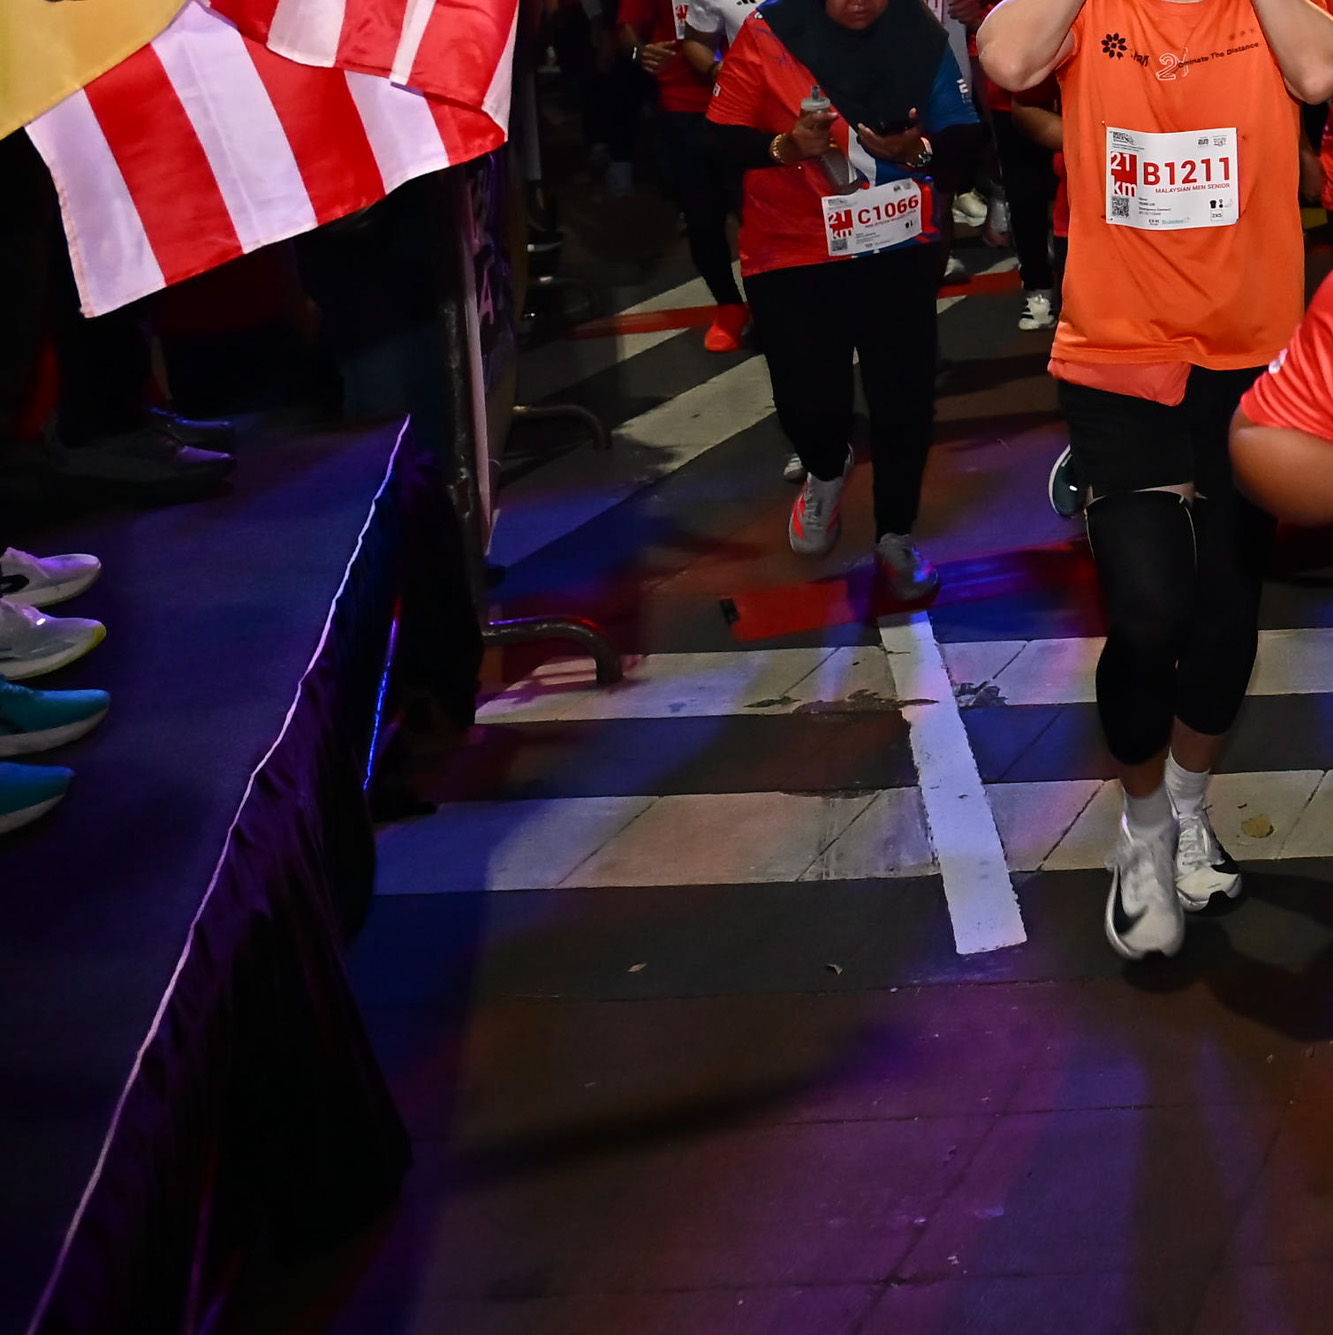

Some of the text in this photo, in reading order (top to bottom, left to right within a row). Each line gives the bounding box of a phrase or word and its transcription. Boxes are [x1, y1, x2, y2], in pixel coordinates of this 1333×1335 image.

[1226, 42, 1260, 55] Distance
[1111, 152, 1230, 186] 21 B1211
[1114, 181, 1137, 197] km
[1155, 186, 1191, 194] MALAYSIAN
[1207, 182, 1230, 190] SENIOR
[828, 210, 846, 224] 21
[857, 194, 919, 225] C1066
